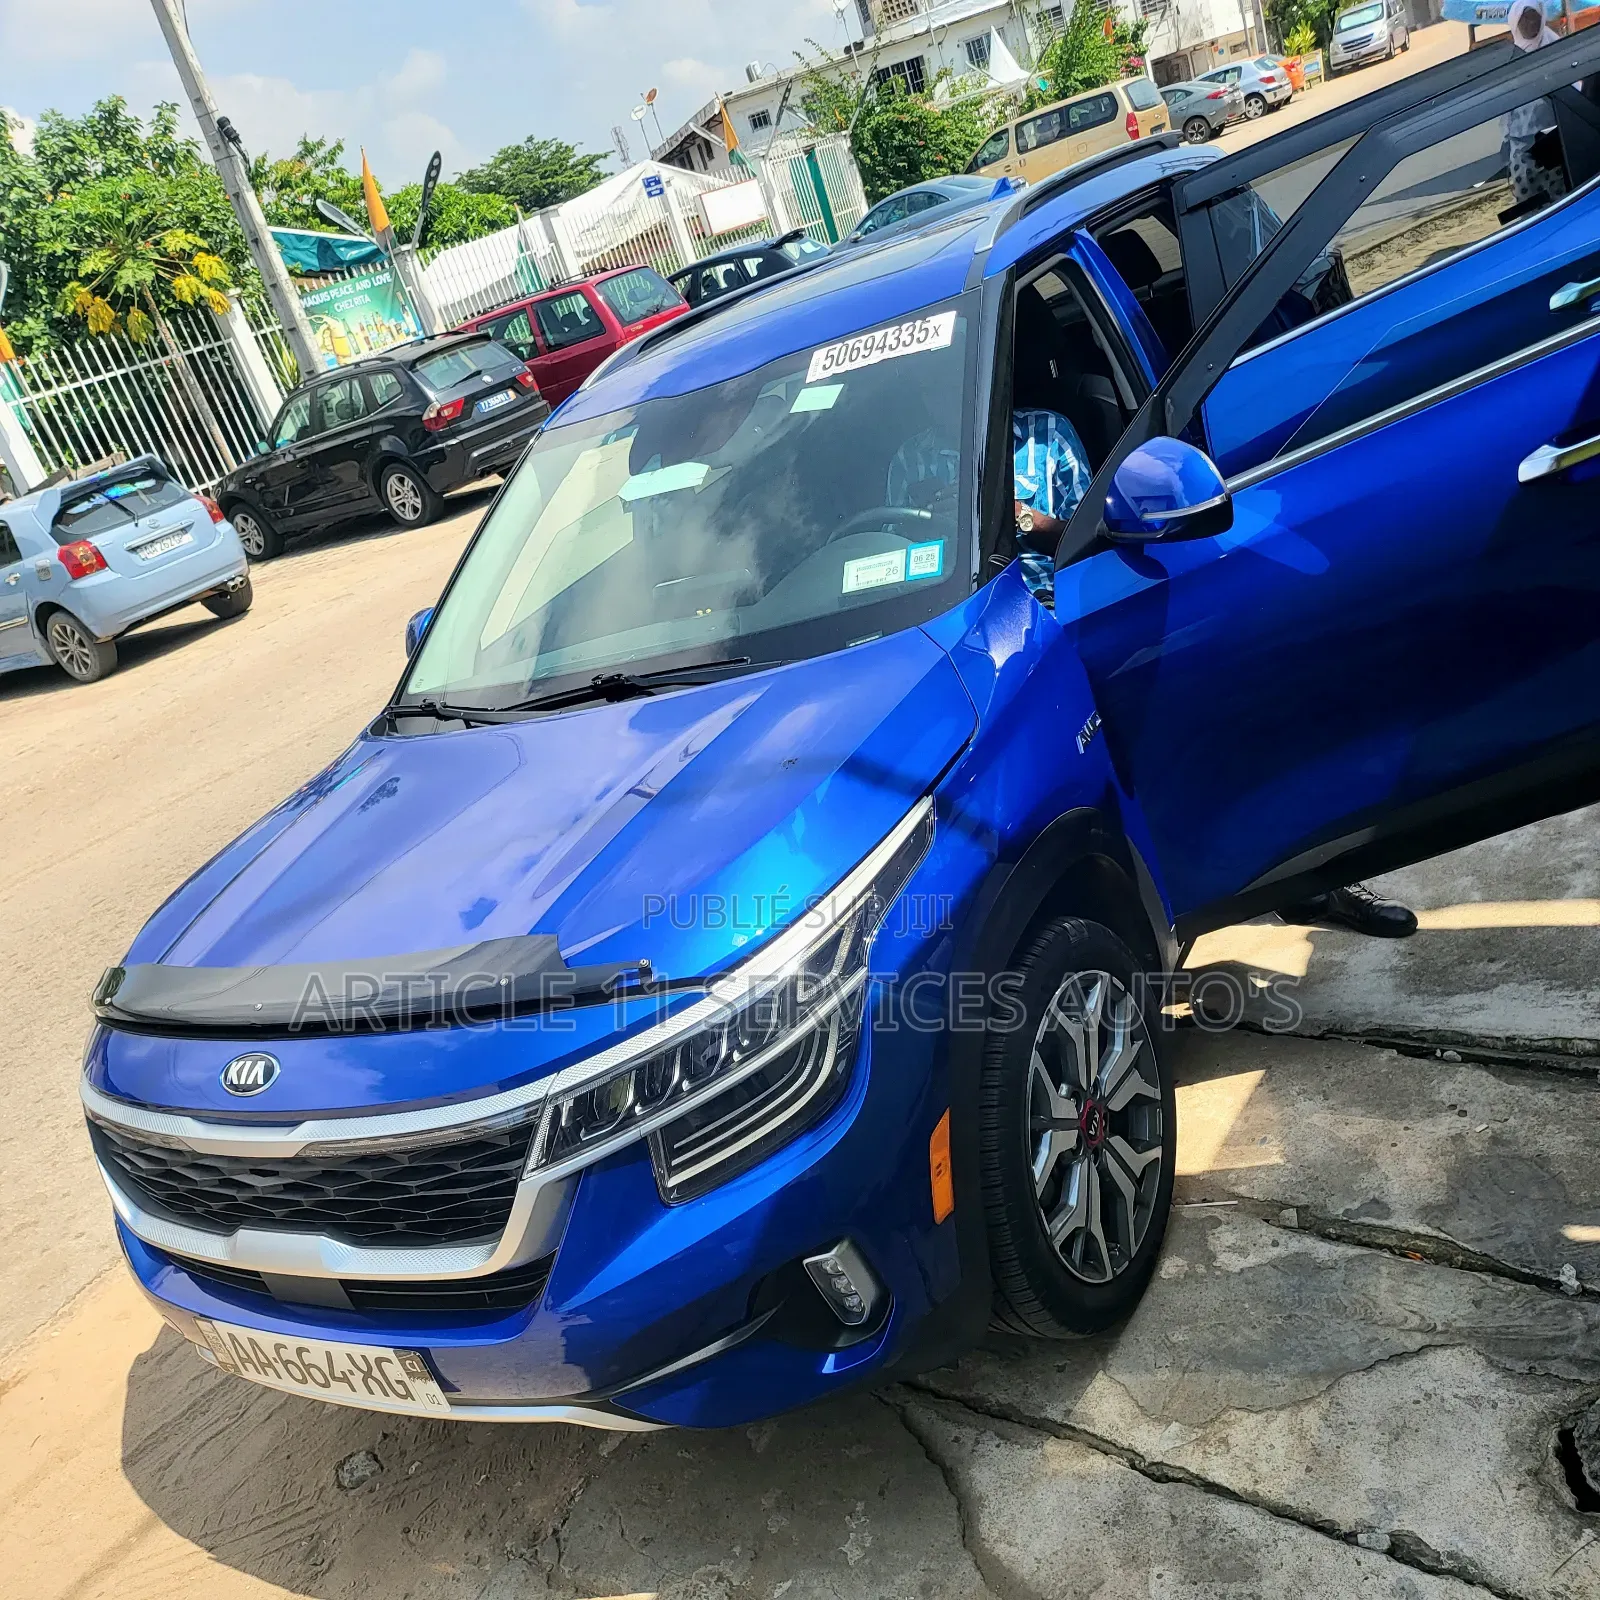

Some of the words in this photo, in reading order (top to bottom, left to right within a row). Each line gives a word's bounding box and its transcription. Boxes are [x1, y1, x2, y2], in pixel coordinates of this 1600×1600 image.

[300, 291, 331, 309] MAQUIS
[330, 283, 355, 300] PEACE
[355, 279, 372, 292] AND
[372, 271, 392, 287] LOVE
[333, 300, 355, 313] CHEZ
[354, 293, 372, 307] RITA
[913, 554, 923, 563] 06
[926, 553, 935, 561] 25
[885, 566, 899, 577] 26
[226, 1060, 266, 1085] KIA
[426, 1393, 442, 1405] 01
